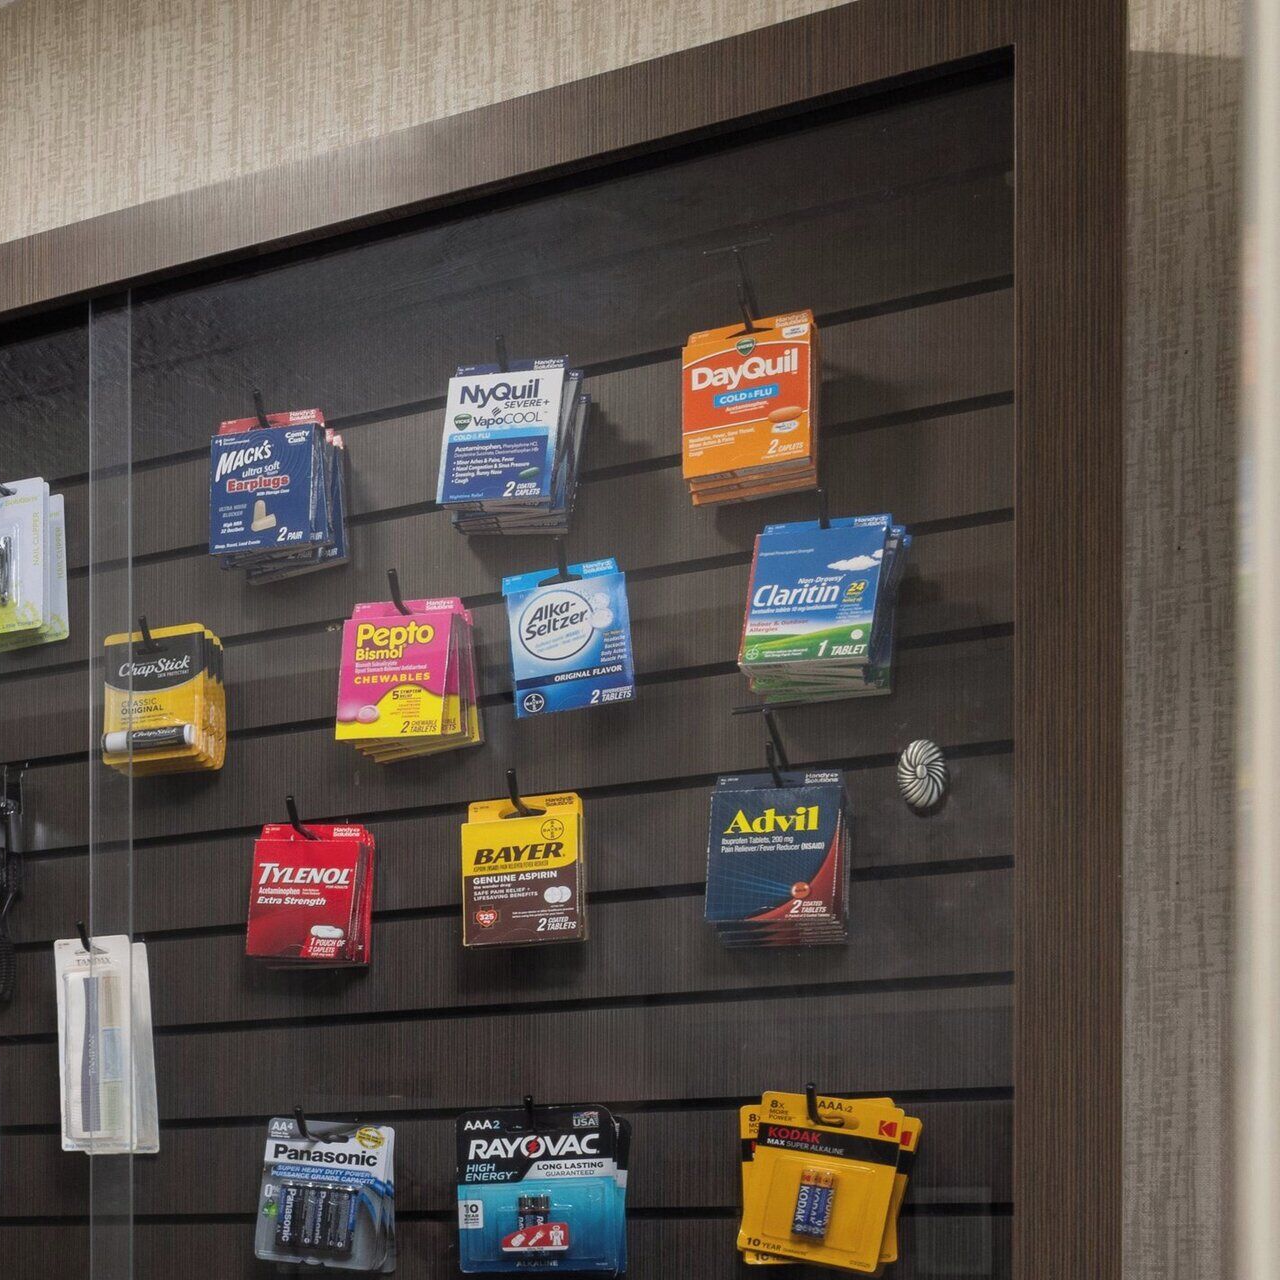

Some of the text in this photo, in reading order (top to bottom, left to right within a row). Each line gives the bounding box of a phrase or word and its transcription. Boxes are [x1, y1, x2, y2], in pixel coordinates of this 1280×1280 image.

[691, 347, 798, 392] DayQuil
[460, 379, 540, 408] NyQuil
[720, 387, 772, 405] COLD FLU
[473, 412, 542, 428] VapoCOOL
[285, 431, 309, 439] Comfy
[768, 438, 804, 455] 2 CAPLETS
[215, 440, 271, 482] MACK'S
[242, 460, 280, 477] ultra soft
[227, 475, 290, 493] Earplugs
[502, 481, 516, 497] 2
[515, 488, 540, 496] CAPLETS
[277, 527, 303, 541] 2 PAIR
[798, 574, 843, 585] Non-Drowsy
[752, 583, 841, 607] Claritin
[528, 600, 576, 626] Alka-
[525, 609, 588, 641] Seltzer
[356, 622, 435, 650] Pepto
[355, 645, 403, 661] Bismol
[818, 640, 829, 657] 1
[831, 644, 867, 656] TABLET
[118, 655, 190, 679] ChapStick
[554, 665, 623, 682] ORIGINAL FLAVOR
[354, 671, 431, 685] CHEWABLES
[121, 698, 157, 708] CLASSIC
[590, 690, 600, 705] 2
[601, 690, 632, 702] TABLETS
[121, 704, 164, 715] ORIGINAL
[723, 805, 819, 834] Advil
[721, 837, 748, 846] Ibuprofen
[473, 841, 564, 865] BAYER
[258, 863, 351, 885] TYLENOL
[473, 871, 557, 885] GENUINE ASPIRIN
[257, 896, 326, 907] Extra Strength
[790, 900, 802, 913] 2
[537, 917, 547, 931] 2
[547, 920, 576, 930] TABLETS
[768, 1126, 821, 1144] KODAK
[468, 1134, 600, 1160] RAYOVAC
[766, 1138, 844, 1155] MAX SUPER ALKALINE
[273, 1143, 377, 1167] Panasonic
[302, 1166, 325, 1174] HEAVY
[466, 1163, 495, 1173] HIGH
[545, 1169, 595, 1177] GUARANTEED
[564, 1161, 604, 1169] LASTING
[271, 1171, 309, 1179] PUISSANCE
[465, 1171, 513, 1182] ENERGY
[762, 1242, 782, 1251] YEAR
